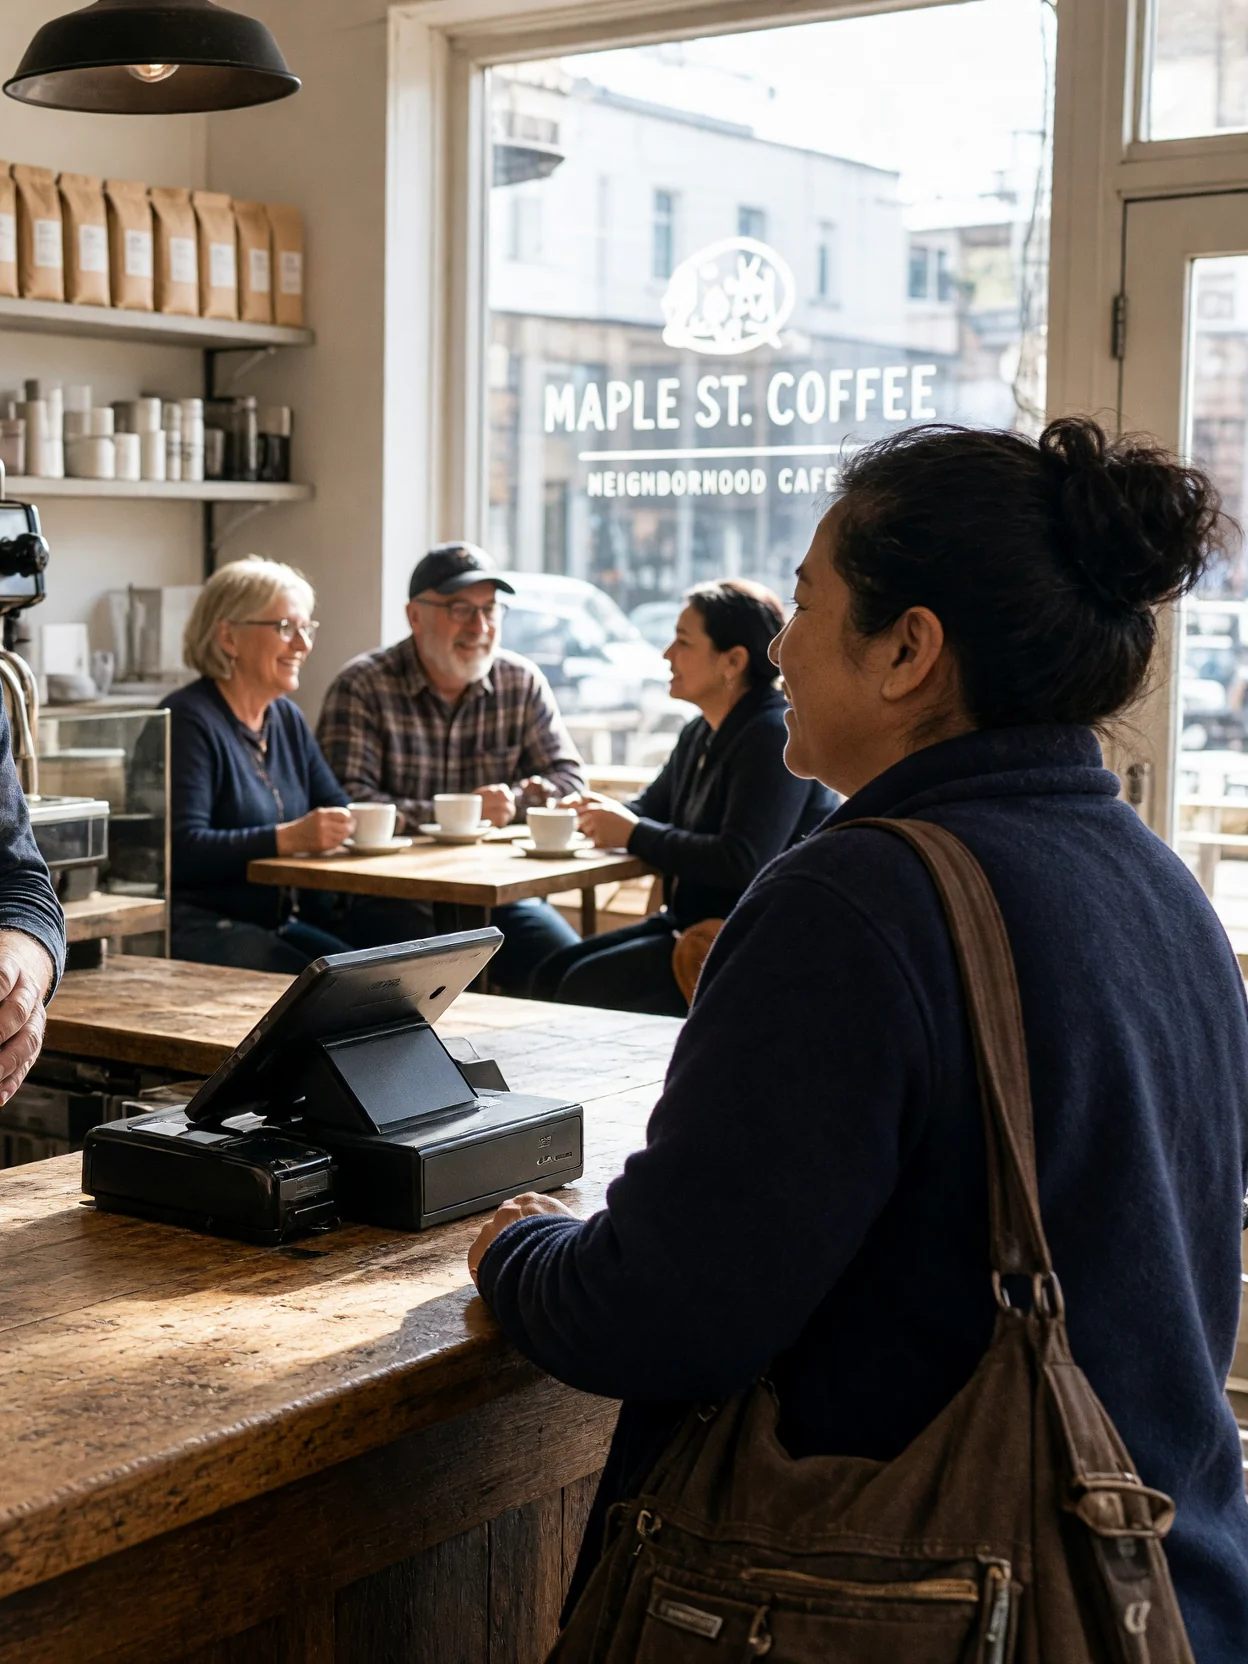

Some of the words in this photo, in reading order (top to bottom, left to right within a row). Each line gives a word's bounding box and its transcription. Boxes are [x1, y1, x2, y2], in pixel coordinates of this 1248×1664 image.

[544, 377, 680, 433] MAPLE
[695, 374, 752, 429] ST.
[767, 364, 937, 426] COFFEE
